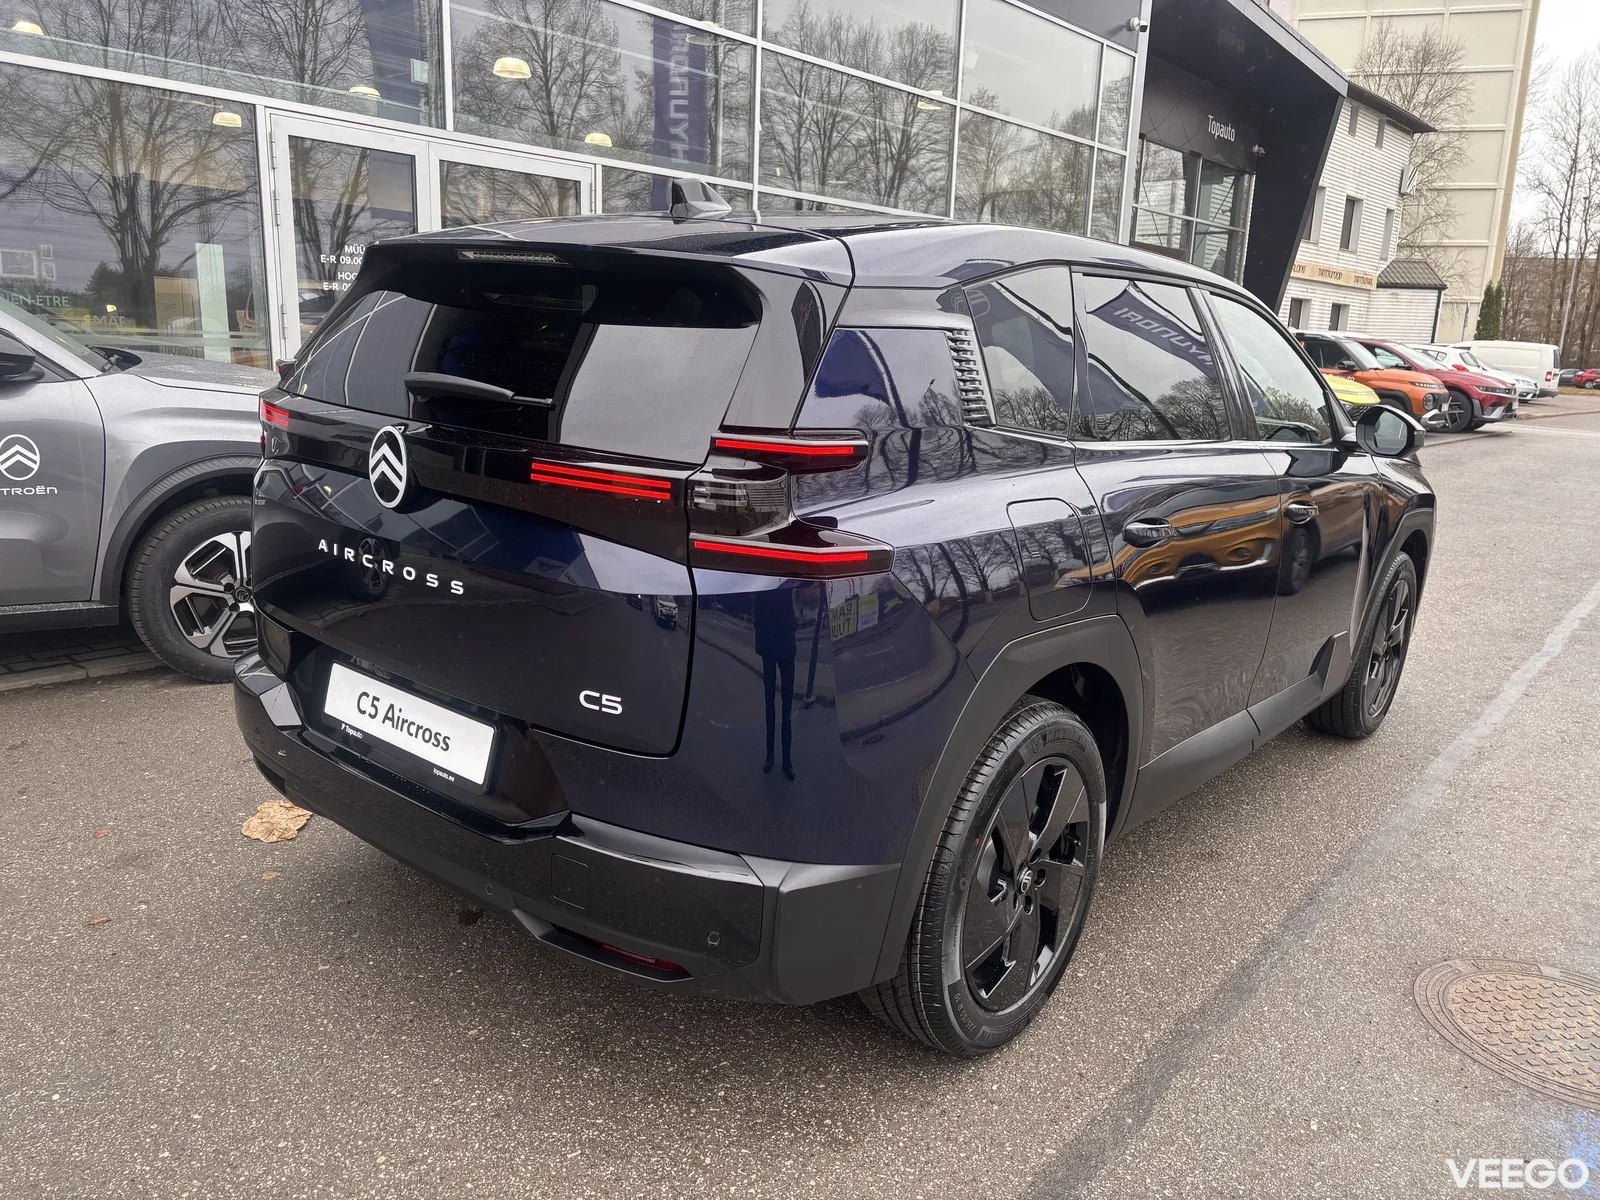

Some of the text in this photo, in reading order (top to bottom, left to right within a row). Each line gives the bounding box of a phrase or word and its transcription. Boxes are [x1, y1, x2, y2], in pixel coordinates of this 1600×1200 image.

[1207, 114, 1236, 142] Topauto
[320, 254, 337, 264] E-R
[323, 281, 339, 291] E-R
[318, 538, 464, 595] AIRCROSS
[579, 690, 622, 715] C5
[356, 691, 451, 752] C5 Aircross
[345, 725, 363, 739] Topauto
[433, 767, 455, 782] topauto.ee
